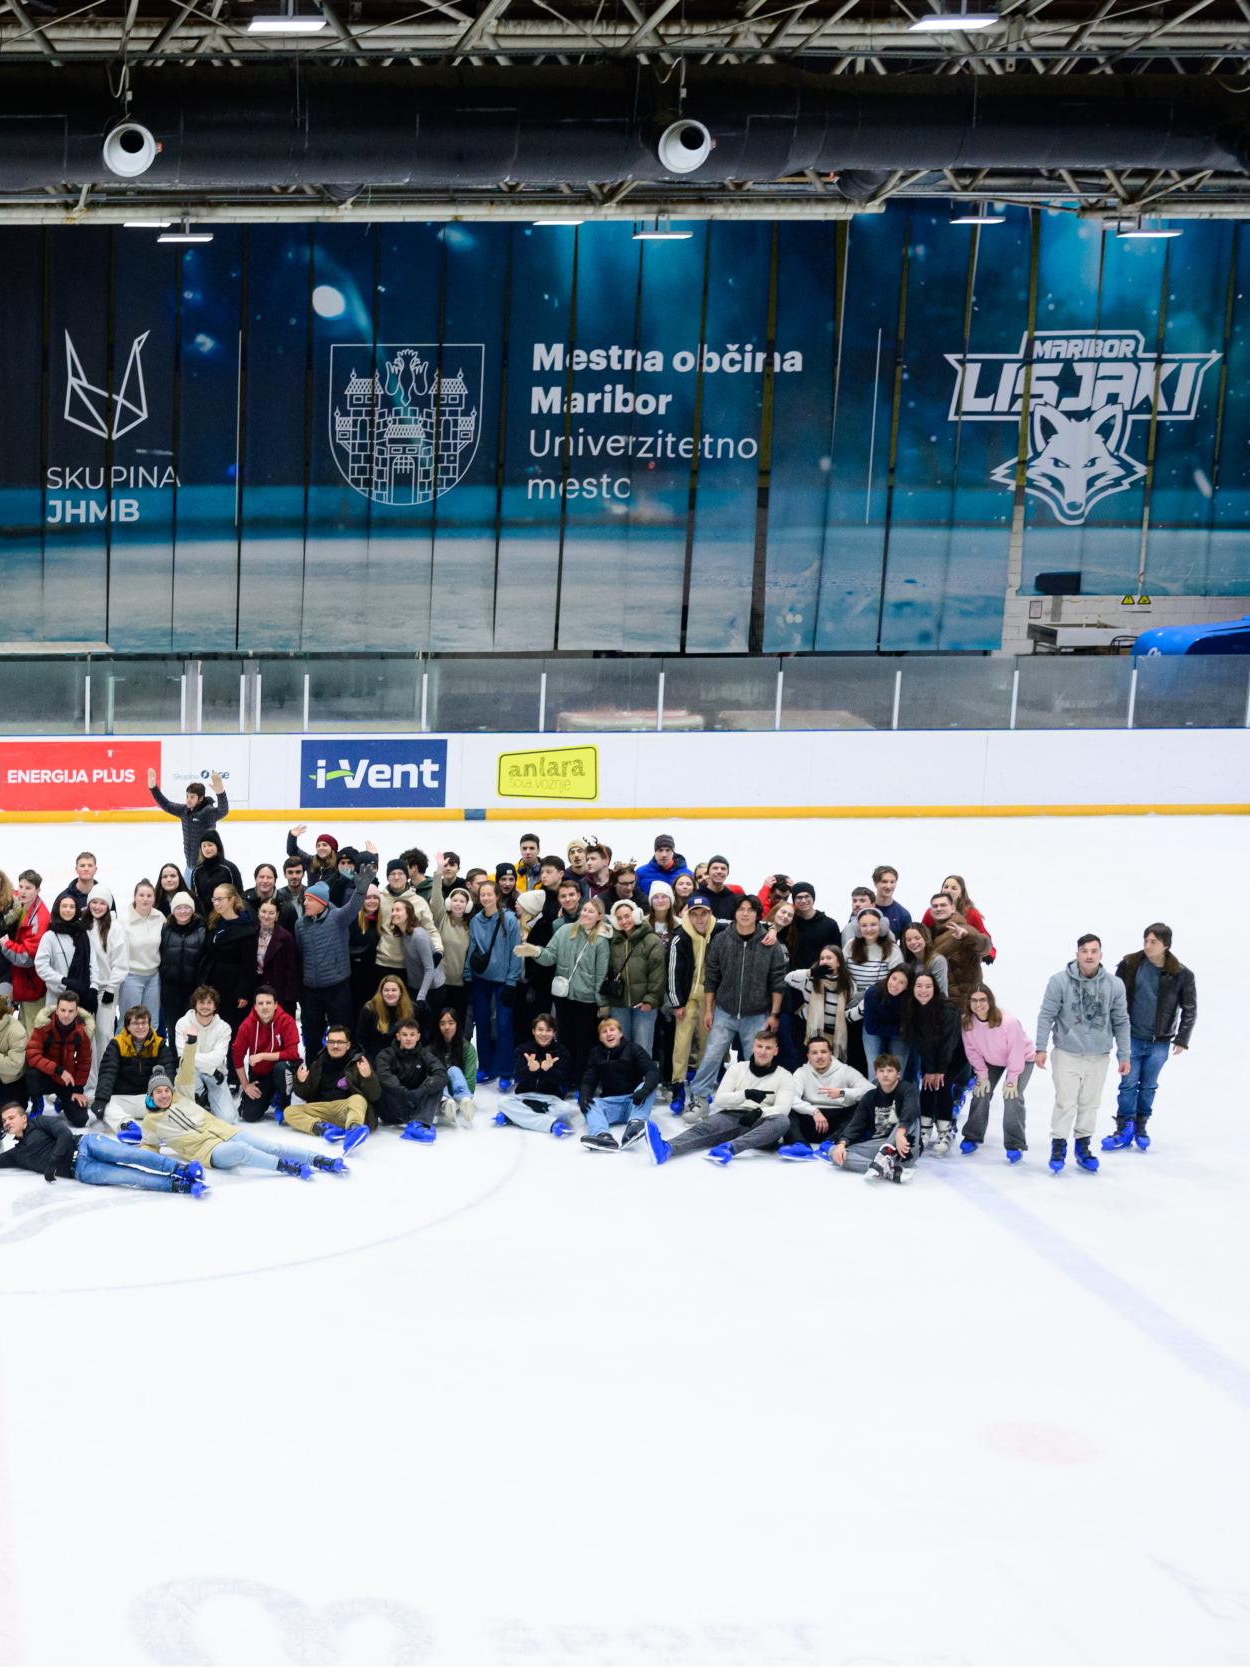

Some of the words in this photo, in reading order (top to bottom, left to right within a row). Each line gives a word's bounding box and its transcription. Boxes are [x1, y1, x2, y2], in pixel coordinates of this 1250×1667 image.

[532, 343, 664, 372] Mestna
[672, 343, 804, 373] občina
[1032, 338, 1136, 360] MARIBOR
[961, 361, 1201, 412] LISJAKI
[530, 384, 672, 415] Maribor
[529, 429, 758, 459] Univerzitetno
[46, 465, 182, 490] SKUPINA
[46, 498, 141, 523] JHMB
[7, 768, 88, 784] ENERGIJA
[92, 768, 136, 784] PLUS
[508, 757, 586, 777] anlara
